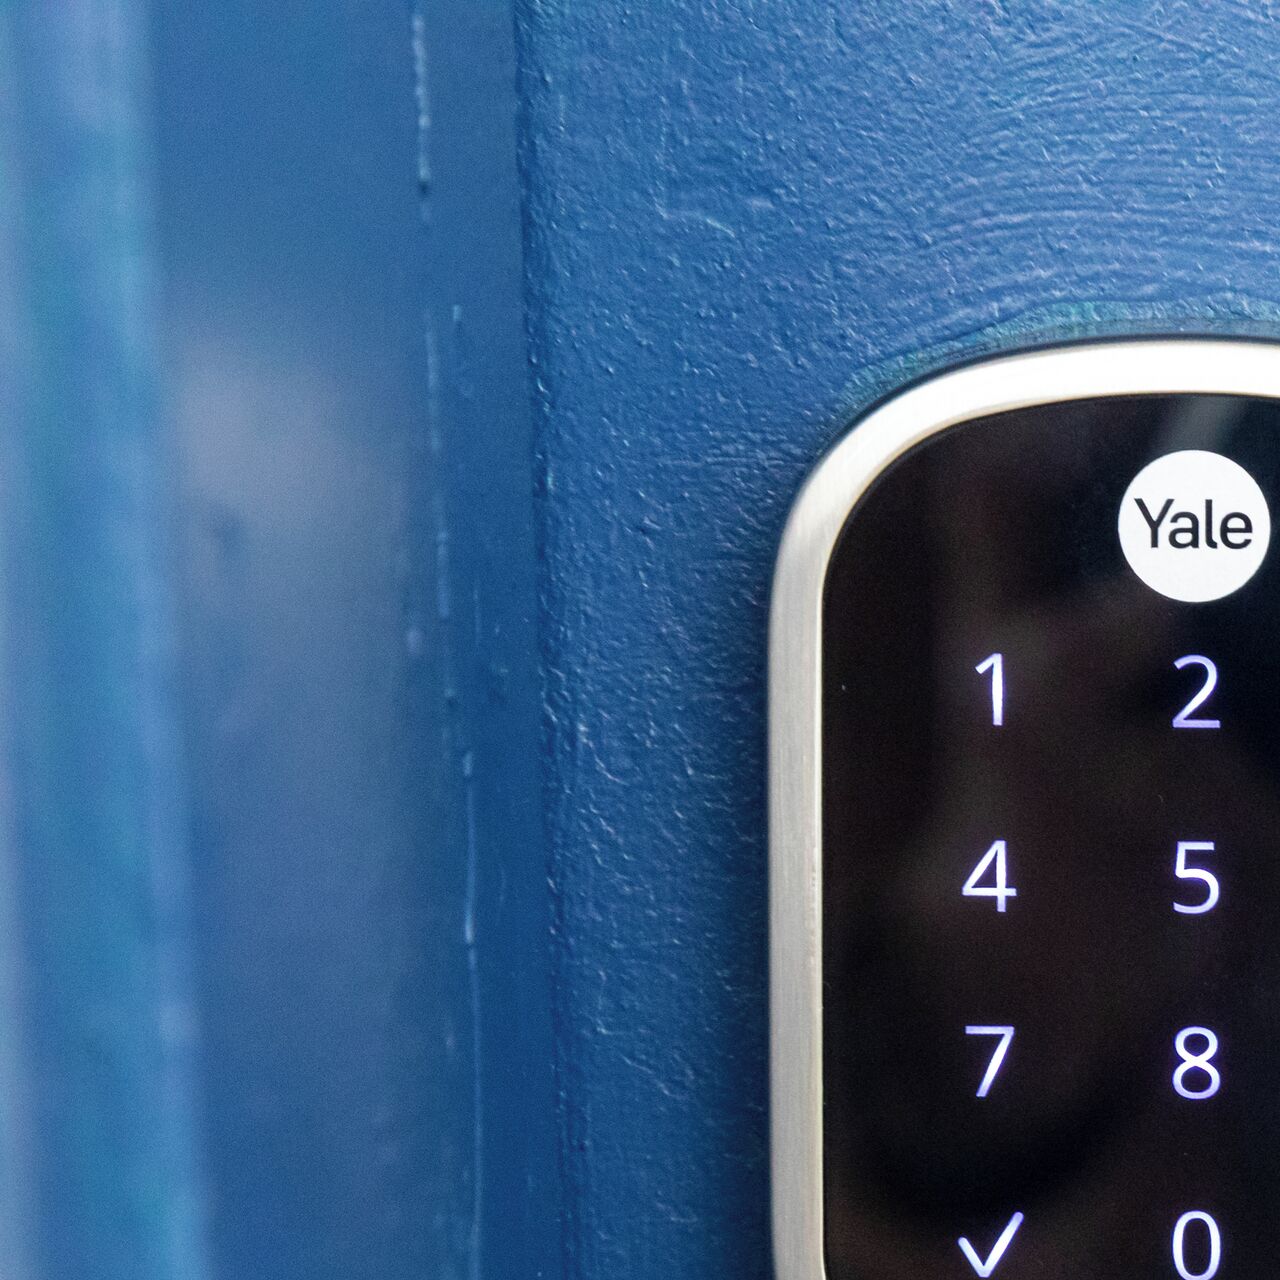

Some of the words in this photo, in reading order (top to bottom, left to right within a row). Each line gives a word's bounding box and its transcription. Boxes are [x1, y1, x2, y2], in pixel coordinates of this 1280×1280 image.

[1133, 498, 1254, 550] Yale
[975, 653, 1005, 727] 1
[1171, 655, 1221, 729] 2
[961, 840, 1017, 914] 4
[1173, 841, 1221, 914] 5
[965, 1025, 1015, 1098] 7
[1172, 1026, 1221, 1100] 8
